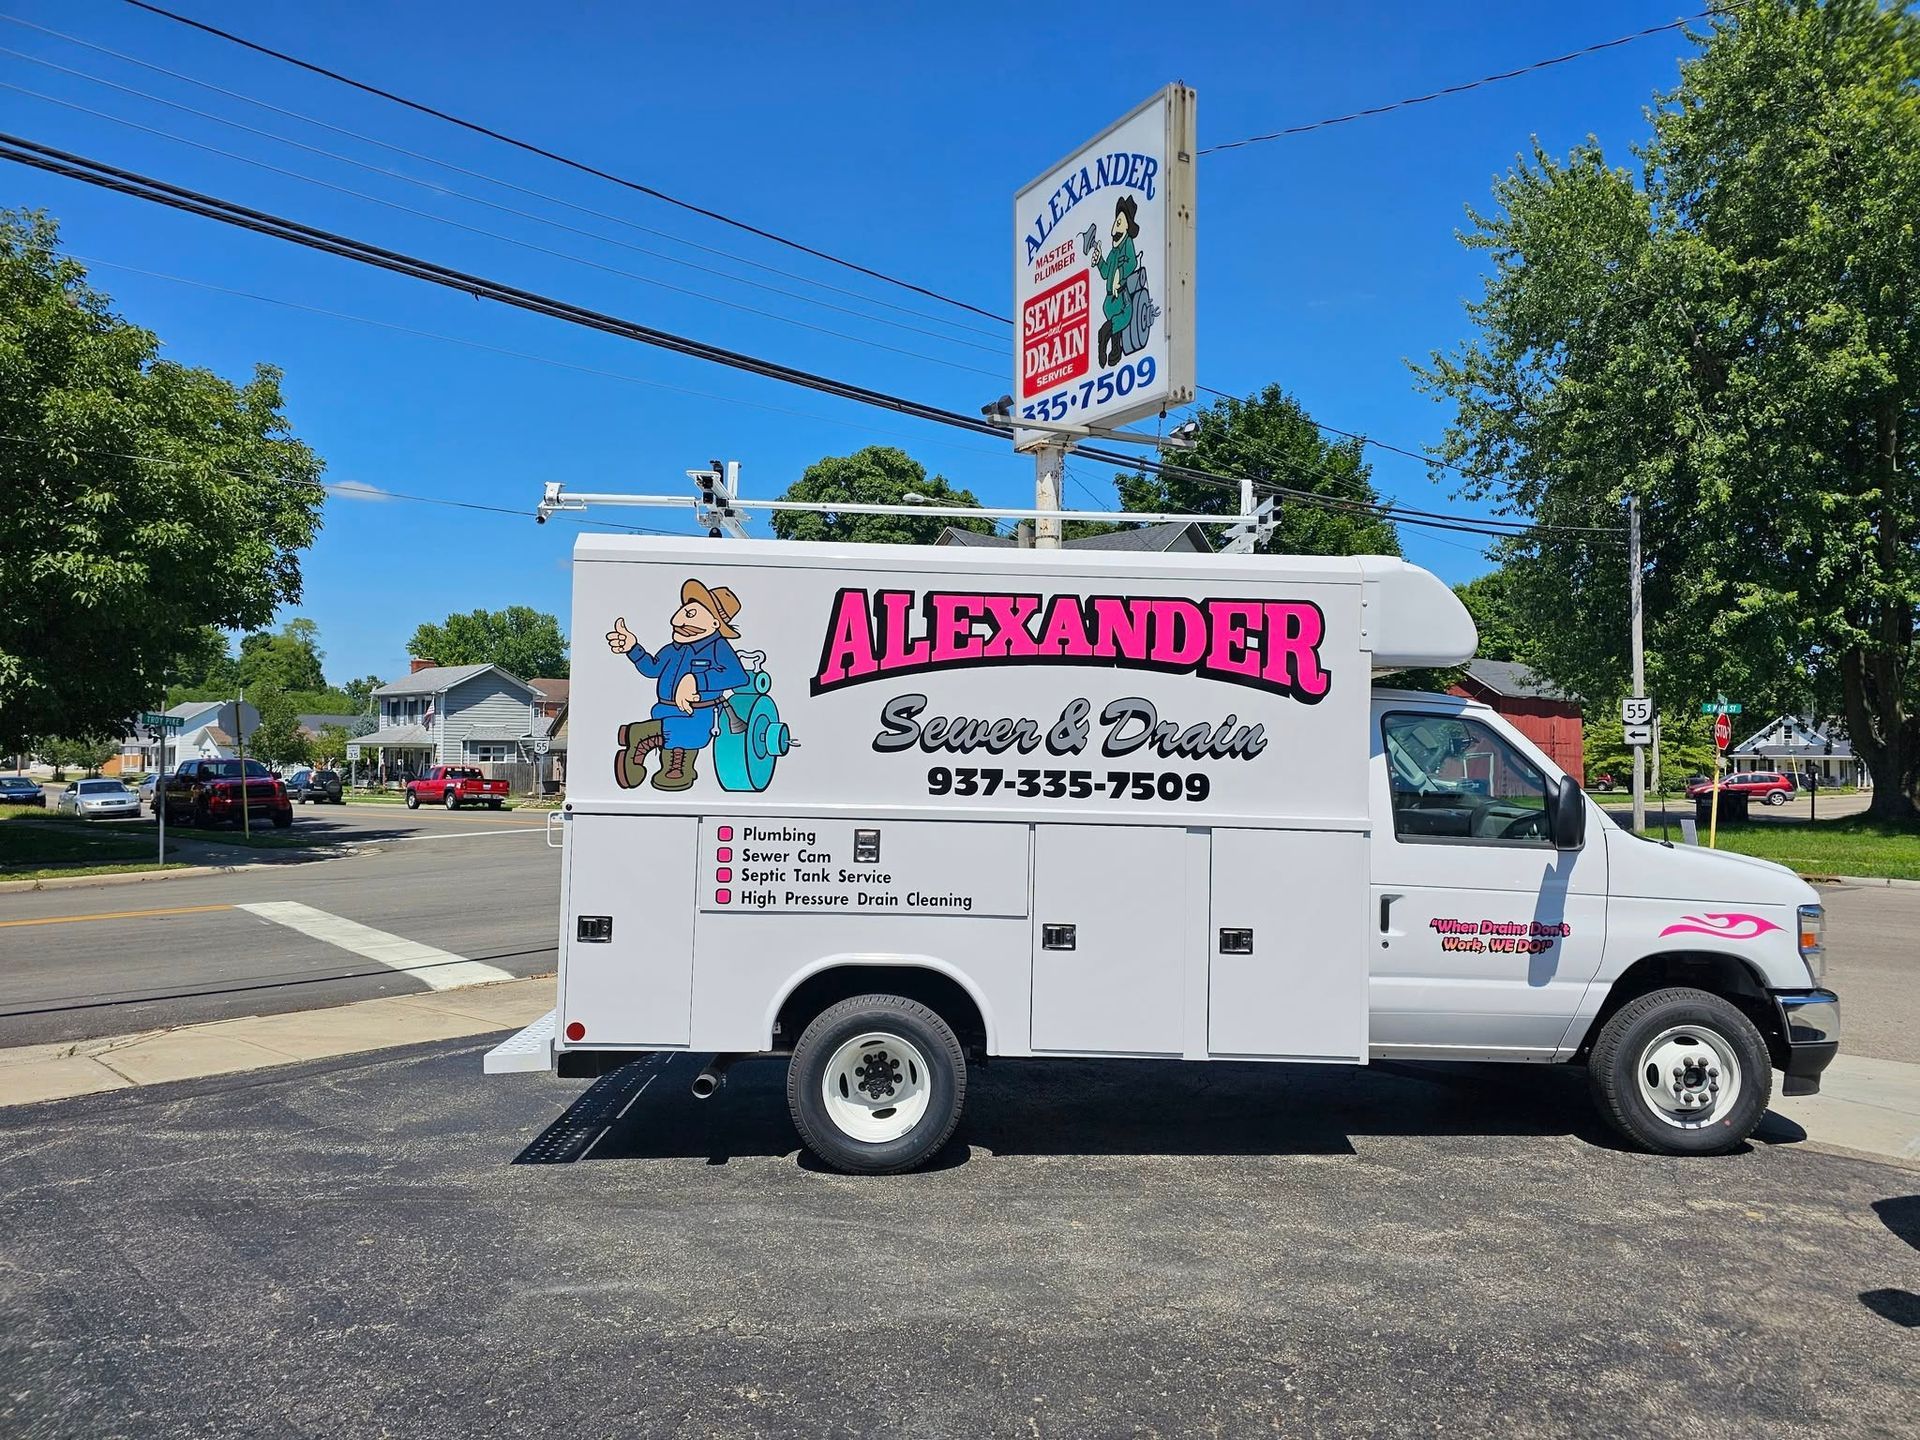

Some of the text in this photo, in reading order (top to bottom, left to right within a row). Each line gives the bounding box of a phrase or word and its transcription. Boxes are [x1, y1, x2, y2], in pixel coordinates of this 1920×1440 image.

[1024, 152, 1158, 266] ALEXANDER
[1035, 239, 1074, 269] MASTER
[1034, 252, 1075, 284] PLUMBER
[1025, 279, 1088, 336] SEWER
[1026, 324, 1087, 379] DRAIN
[1036, 363, 1074, 387] SERVICE
[810, 588, 1332, 705] ALEXANDER
[1627, 703, 1647, 719] 55
[1729, 704, 1737, 712] ST
[872, 694, 1268, 760] Sewer & Drain
[1717, 724, 1730, 740] STOP
[536, 742, 547, 752] 55
[927, 767, 1210, 801] 937-335-7509
[743, 828, 816, 845] Plumbing
[742, 849, 831, 863] Sewer Cam
[741, 869, 892, 885] Septic Tank Service
[741, 891, 972, 910] High Pressure Drain Cleaning
[1480, 920, 1528, 935] Drains
[1442, 936, 1486, 954] Work,
[1489, 938, 1515, 953] WE
